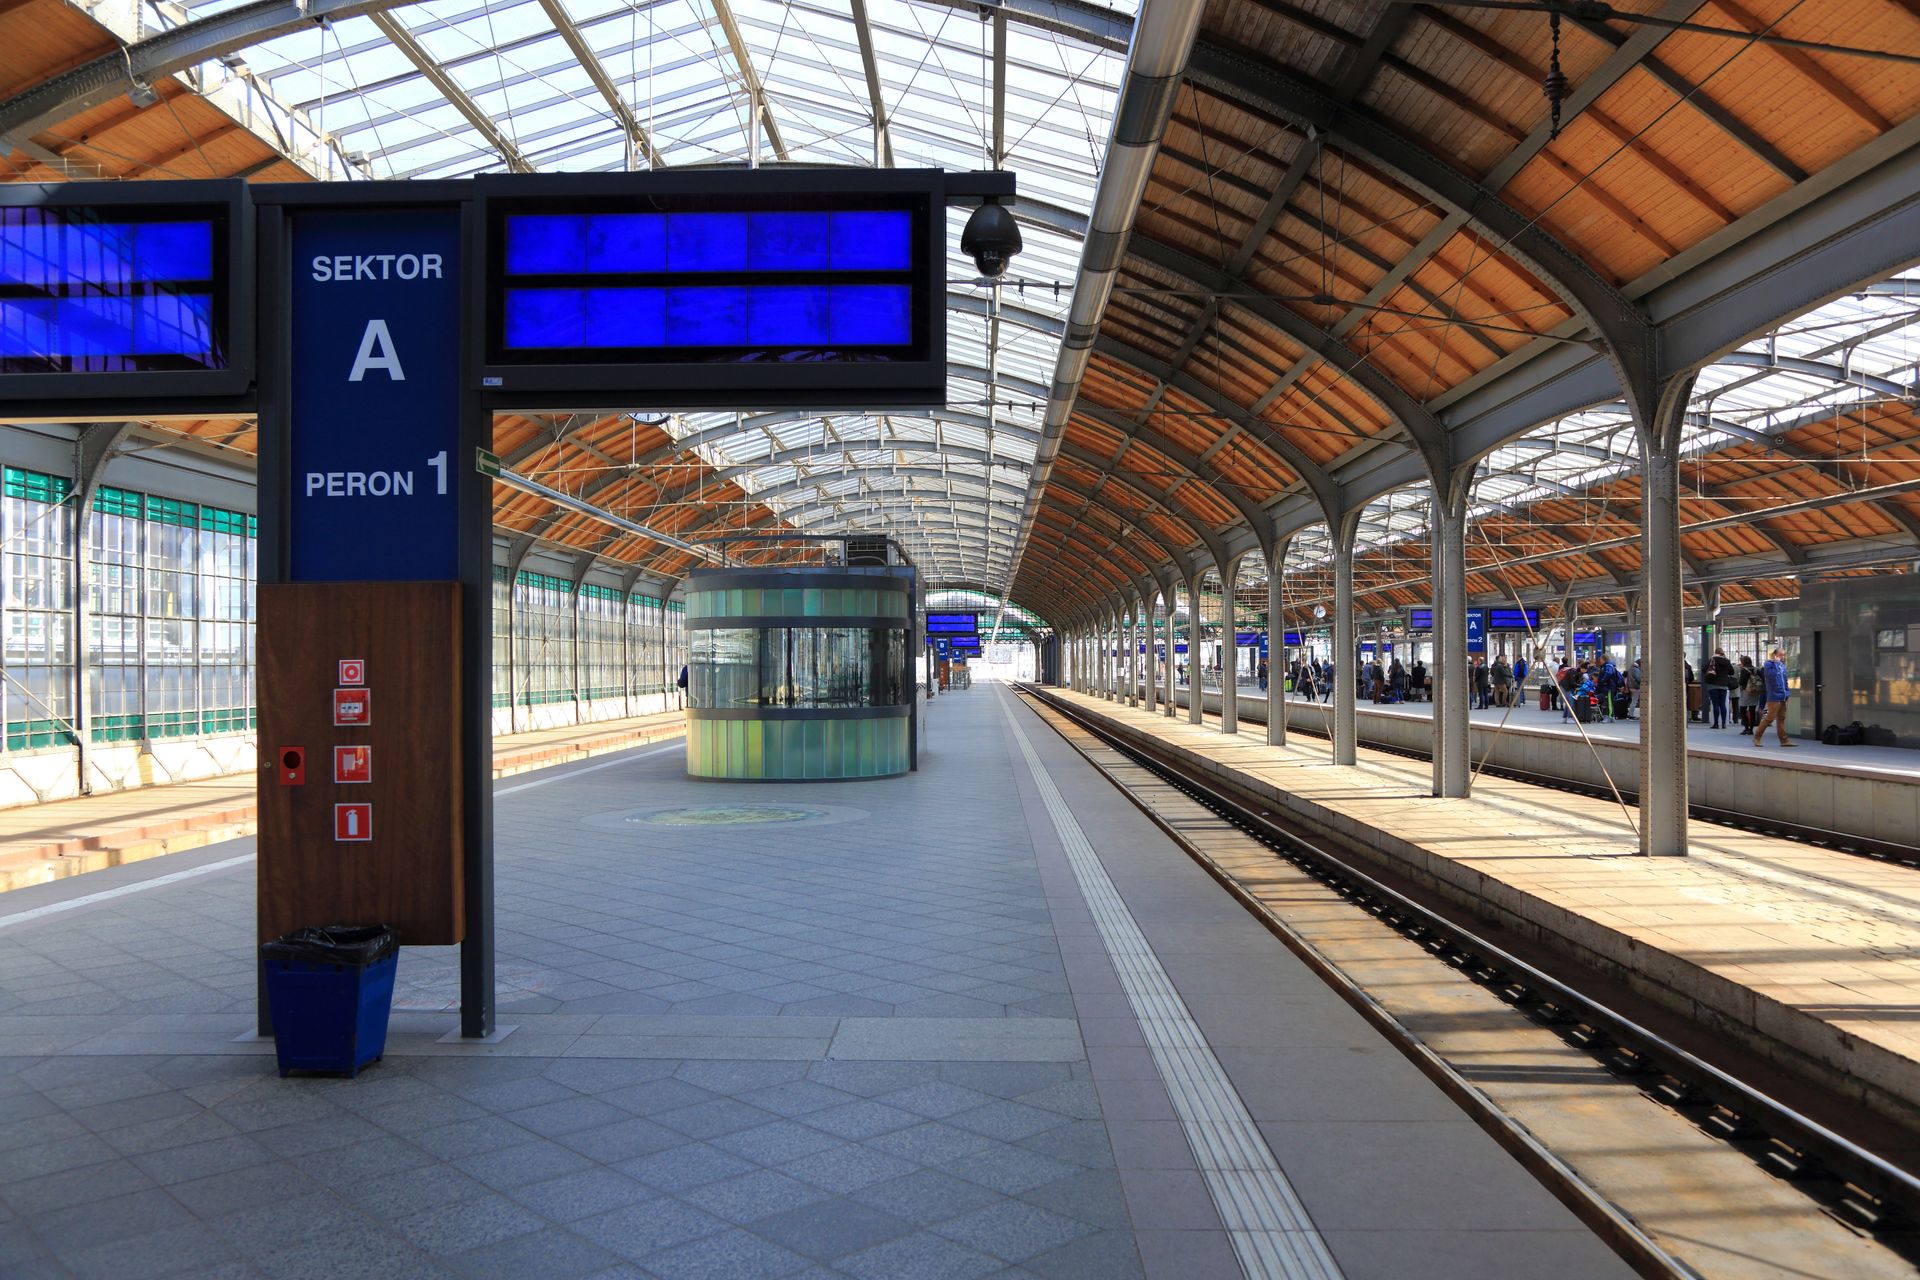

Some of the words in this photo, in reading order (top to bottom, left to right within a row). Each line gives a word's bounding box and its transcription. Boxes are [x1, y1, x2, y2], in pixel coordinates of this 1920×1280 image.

[312, 253, 443, 282] SEKTOR
[348, 319, 406, 382] A
[306, 471, 413, 497] PERON
[427, 450, 448, 495] 1
[1469, 621, 1477, 629] A
